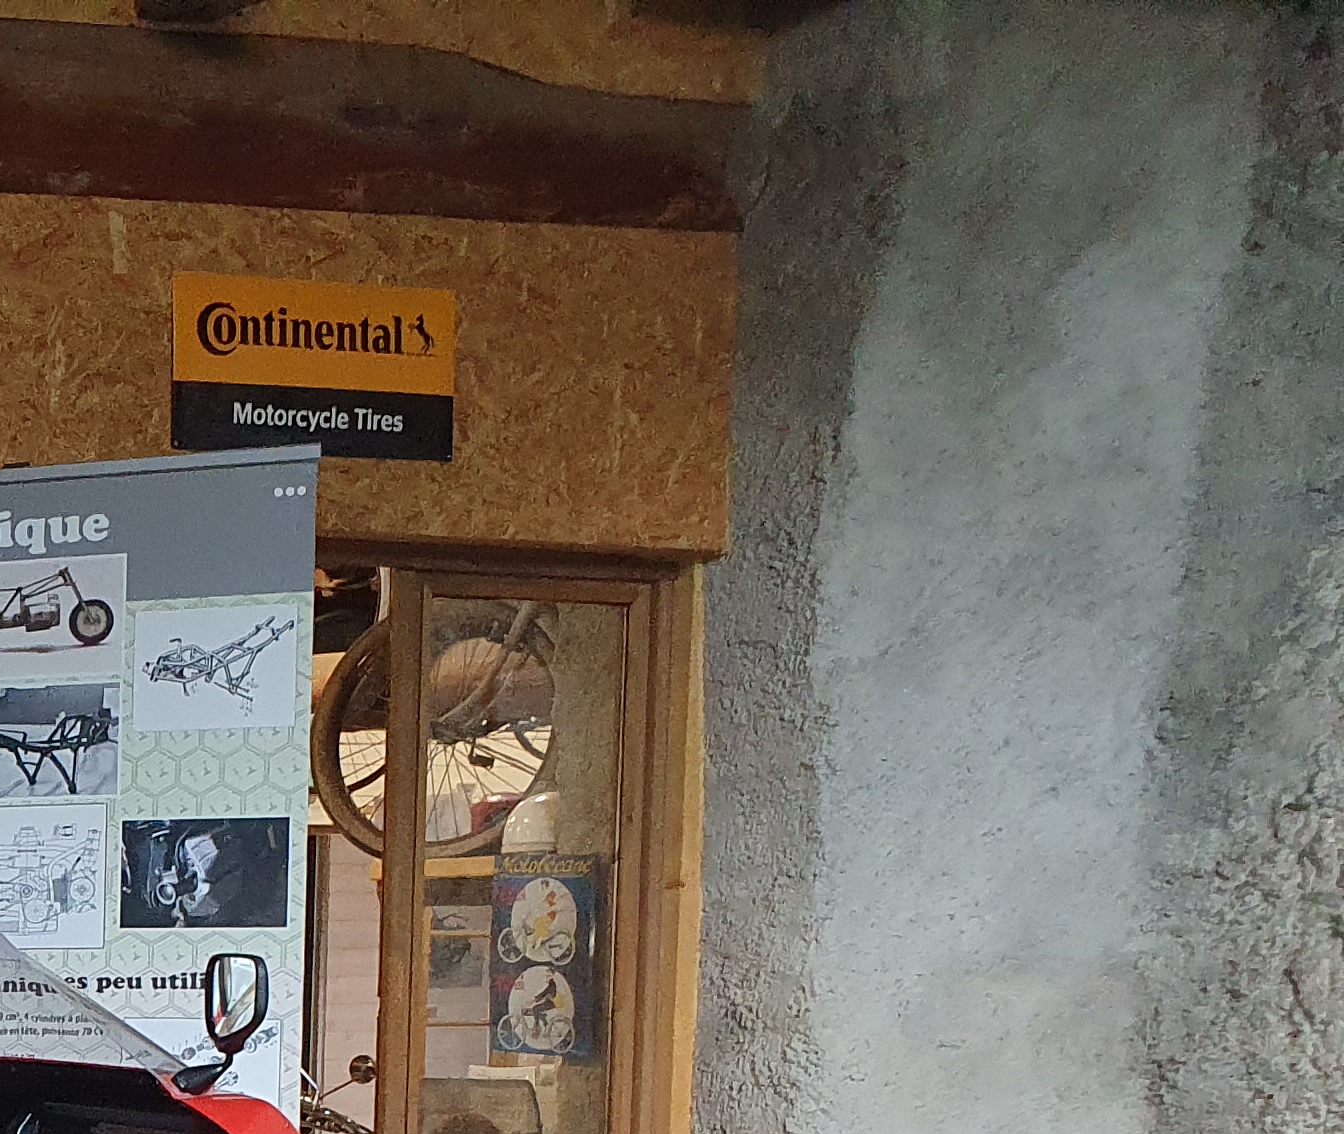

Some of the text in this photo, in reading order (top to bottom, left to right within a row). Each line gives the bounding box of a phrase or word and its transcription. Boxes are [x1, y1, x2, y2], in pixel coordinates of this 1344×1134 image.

[197, 302, 403, 356] Continental
[232, 402, 404, 432] Motorcycle Tires
[95, 975, 144, 994] peu
[150, 972, 207, 991] utili
